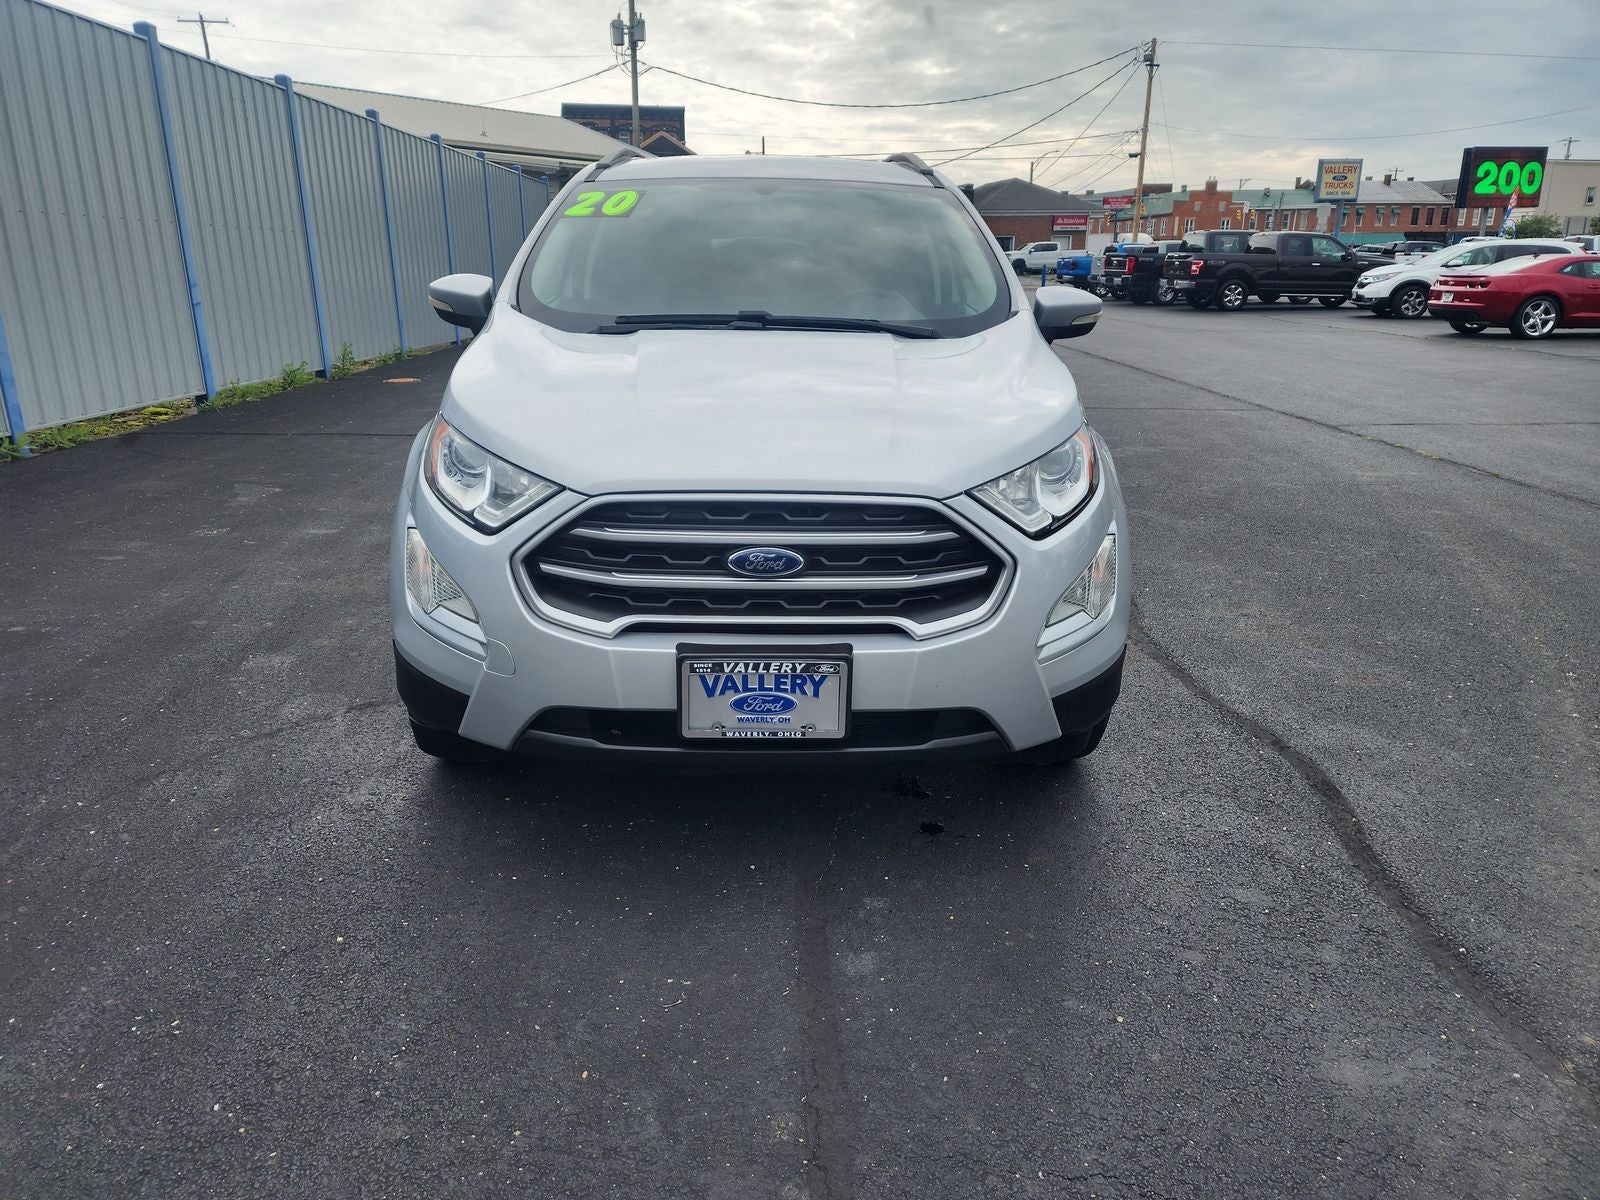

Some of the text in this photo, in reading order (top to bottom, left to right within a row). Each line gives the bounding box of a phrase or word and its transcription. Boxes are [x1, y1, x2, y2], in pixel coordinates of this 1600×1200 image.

[1324, 165, 1358, 174] VALLERY
[1474, 161, 1543, 195] 200
[564, 189, 639, 217] 20
[745, 552, 786, 570] Ford
[723, 662, 806, 673] VALLERY
[699, 674, 829, 698] VALLERY
[743, 695, 784, 712] Ford
